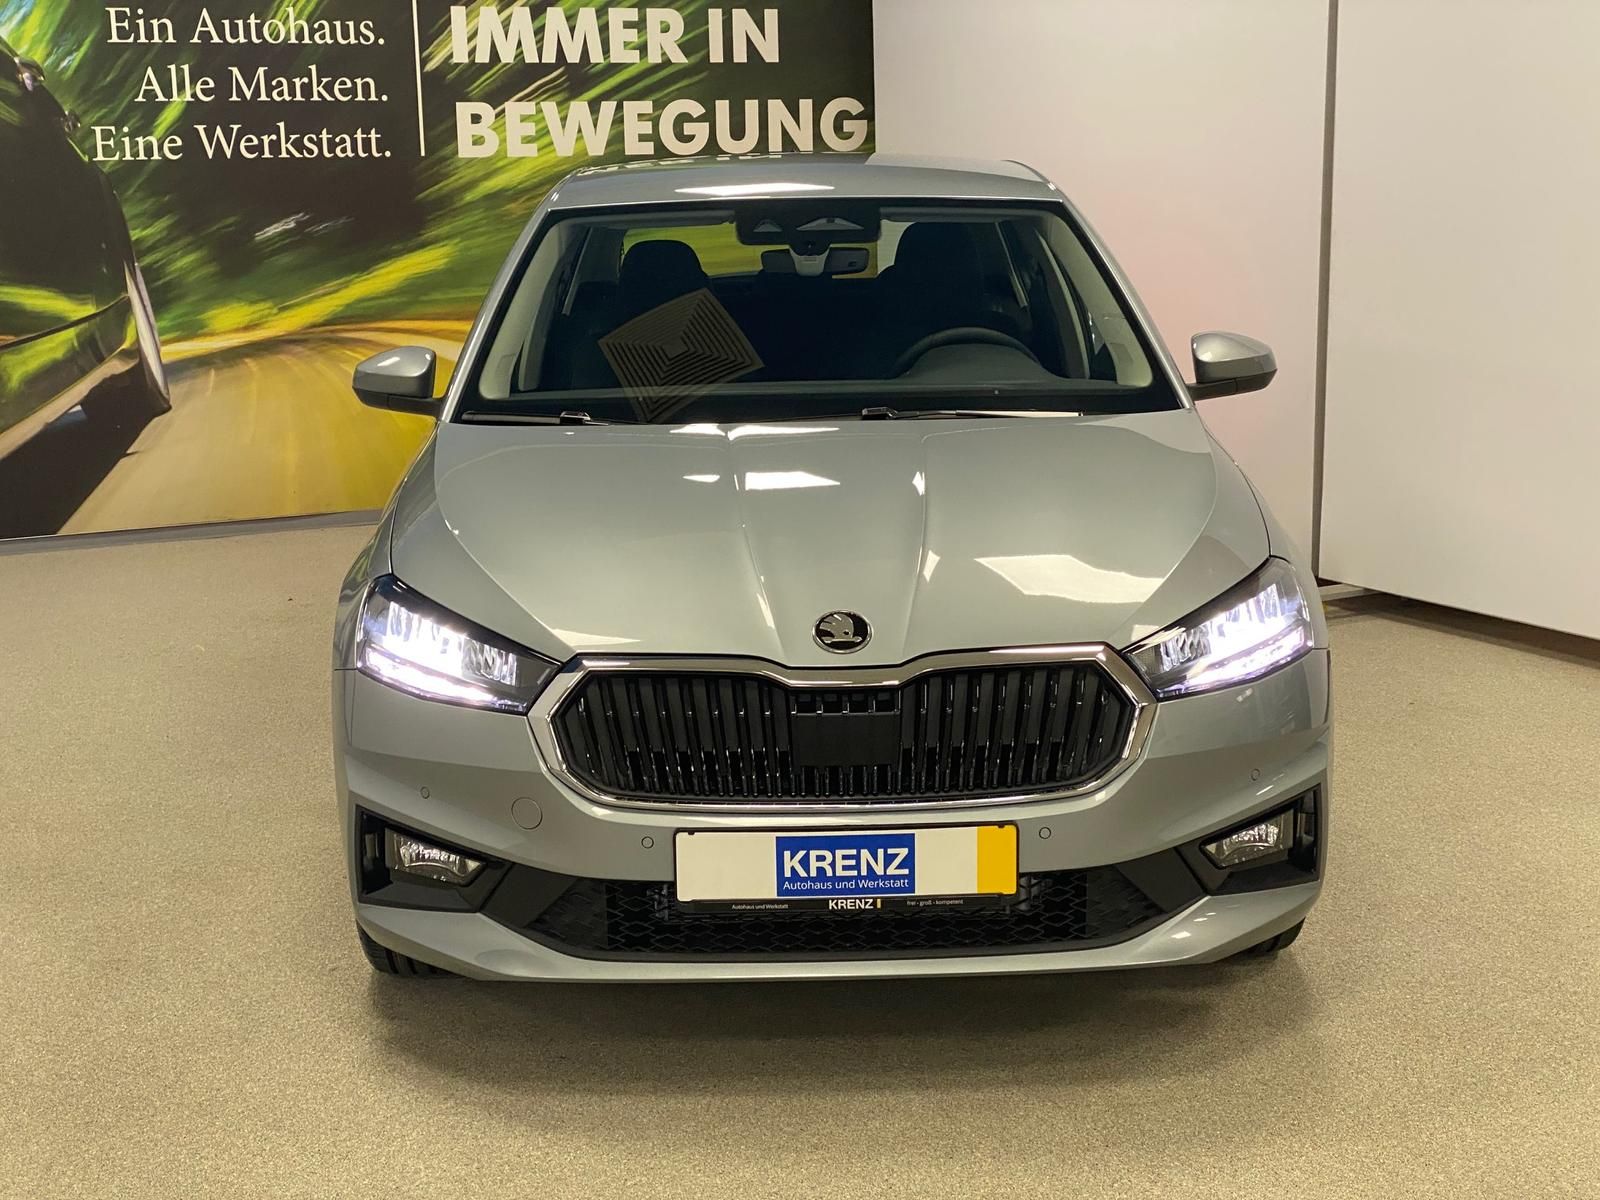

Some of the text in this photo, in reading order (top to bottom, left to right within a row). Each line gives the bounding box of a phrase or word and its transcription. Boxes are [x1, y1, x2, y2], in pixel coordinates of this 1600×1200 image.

[105, 7, 386, 45] Ein Autohaus.
[450, 5, 780, 64] IMMER IN
[134, 64, 389, 102] Alle Marken.
[90, 121, 391, 162] Eine Werkstatt.
[455, 97, 868, 158] BEWEGUNG
[783, 847, 910, 878] KRENZ
[783, 878, 909, 890] Autohaus und Werkstatt
[828, 898, 874, 910] KRENZ
